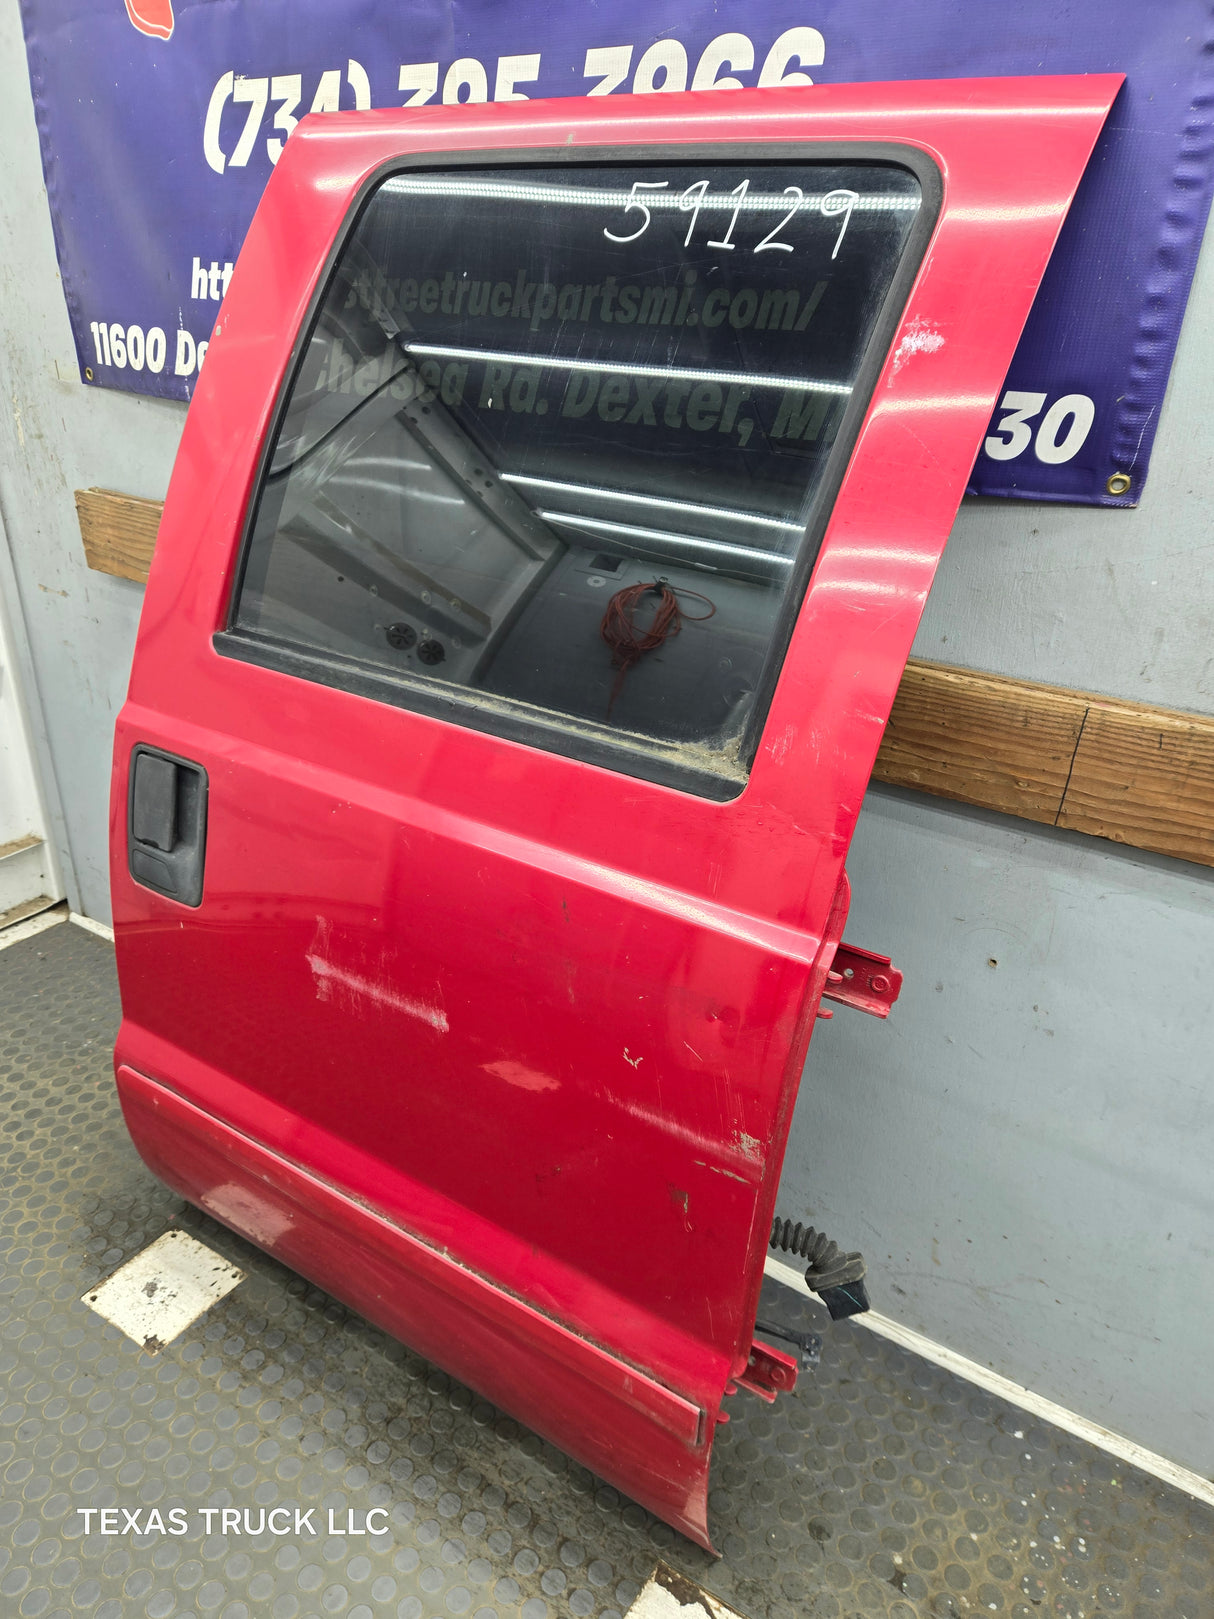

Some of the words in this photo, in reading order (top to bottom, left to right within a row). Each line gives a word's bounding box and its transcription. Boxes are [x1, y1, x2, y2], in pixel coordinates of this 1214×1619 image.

[603, 178, 860, 260] 59129
[90, 321, 167, 374] 11600
[984, 390, 1096, 465] 30
